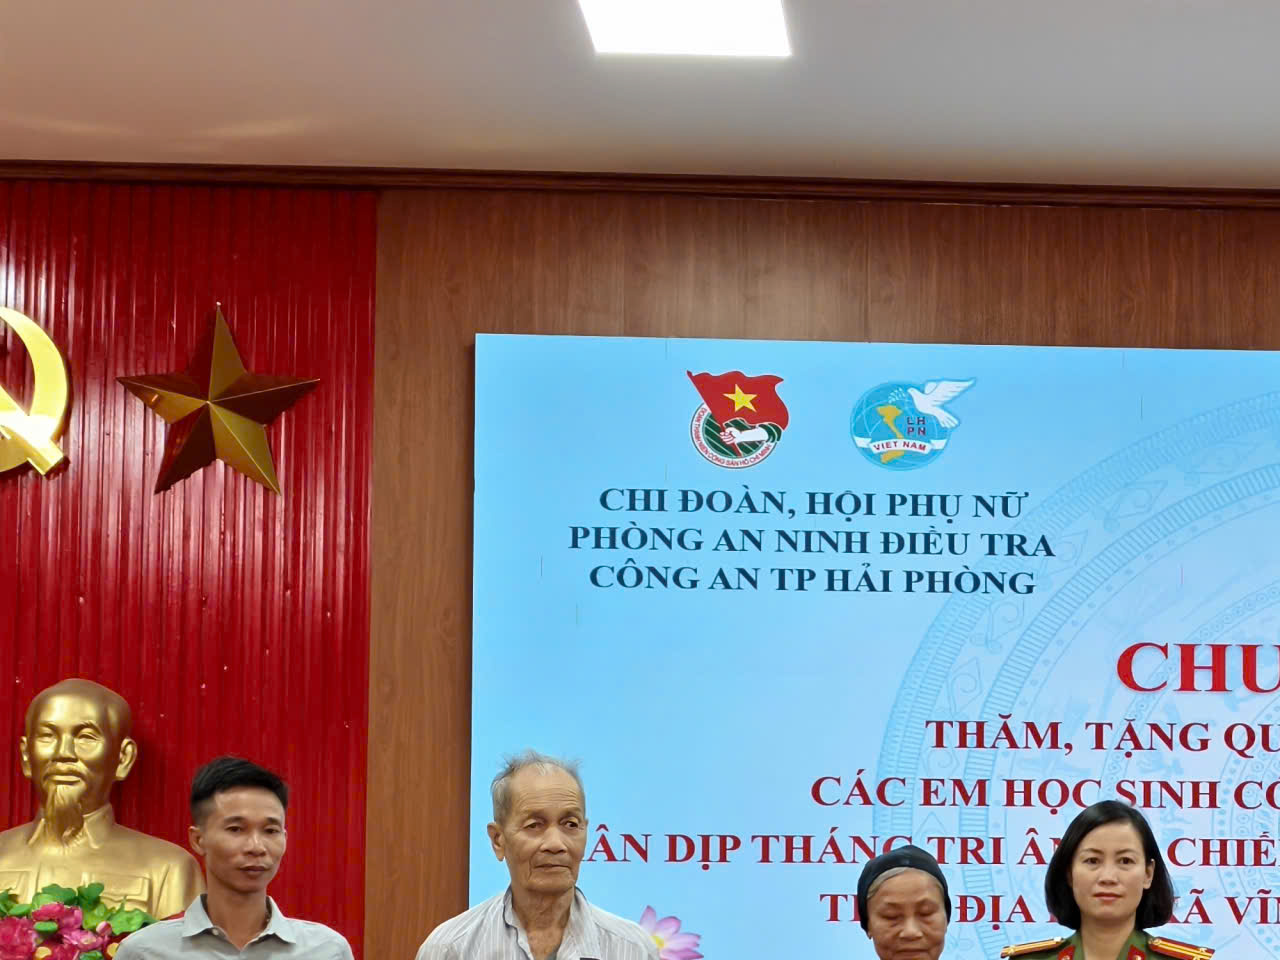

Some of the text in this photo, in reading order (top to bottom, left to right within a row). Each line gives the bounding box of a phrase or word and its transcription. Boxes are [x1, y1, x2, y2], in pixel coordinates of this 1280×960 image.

[902, 441, 927, 451] NAM
[600, 484, 1030, 524] CHI ĐOÀN, HỘI PHỤ NỮ
[569, 525, 1056, 557] PHÒNG AN NINH ĐIỀU TRA
[589, 557, 1036, 595] CÔNG AN TP HẢI PHÒNG
[926, 713, 1073, 755] THĂM,
[1085, 718, 1211, 760] TẶNG
[811, 768, 906, 807] CÁC
[921, 779, 988, 807] EM
[1004, 779, 1102, 816] HỌC
[1112, 780, 1220, 810] SINH
[581, 823, 652, 864] ÂN
[664, 834, 742, 871] DỊP
[927, 836, 1006, 865] TRI
[955, 895, 1036, 931] ĐỊA
